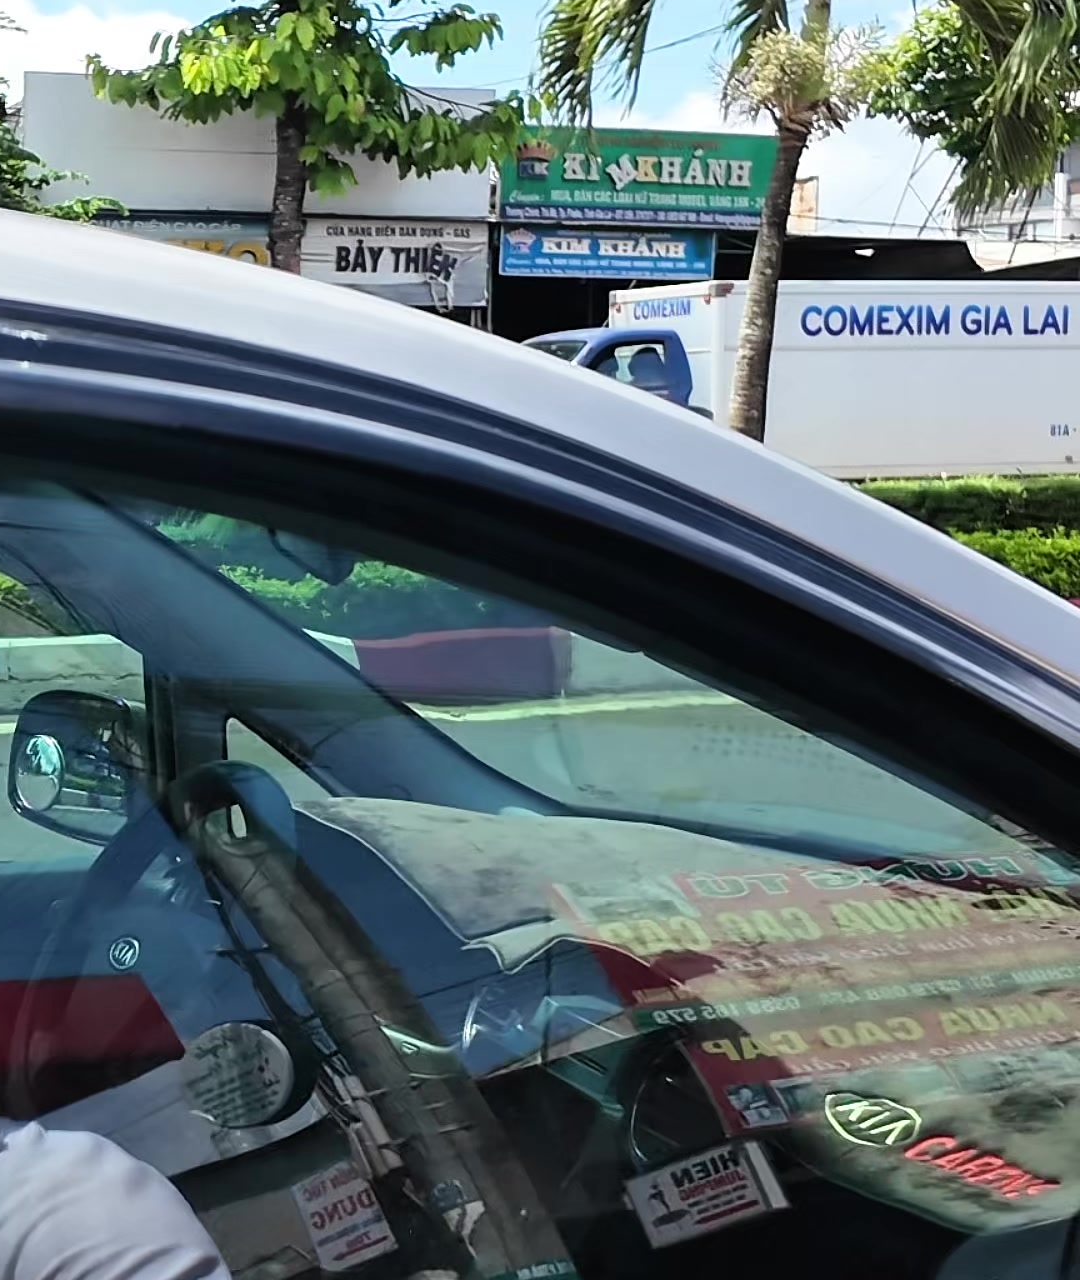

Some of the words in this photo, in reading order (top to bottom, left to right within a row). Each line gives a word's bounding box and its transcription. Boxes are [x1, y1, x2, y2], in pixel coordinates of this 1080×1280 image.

[635, 148, 753, 187] KHÁNH
[540, 236, 592, 255] KIM
[598, 235, 687, 259] KHÁNH
[633, 299, 691, 320] COMEXIM
[800, 304, 951, 337] COMEXIM
[960, 304, 1013, 336] GIA
[1023, 304, 1069, 336] LAI
[834, 1099, 912, 1146] KIA
